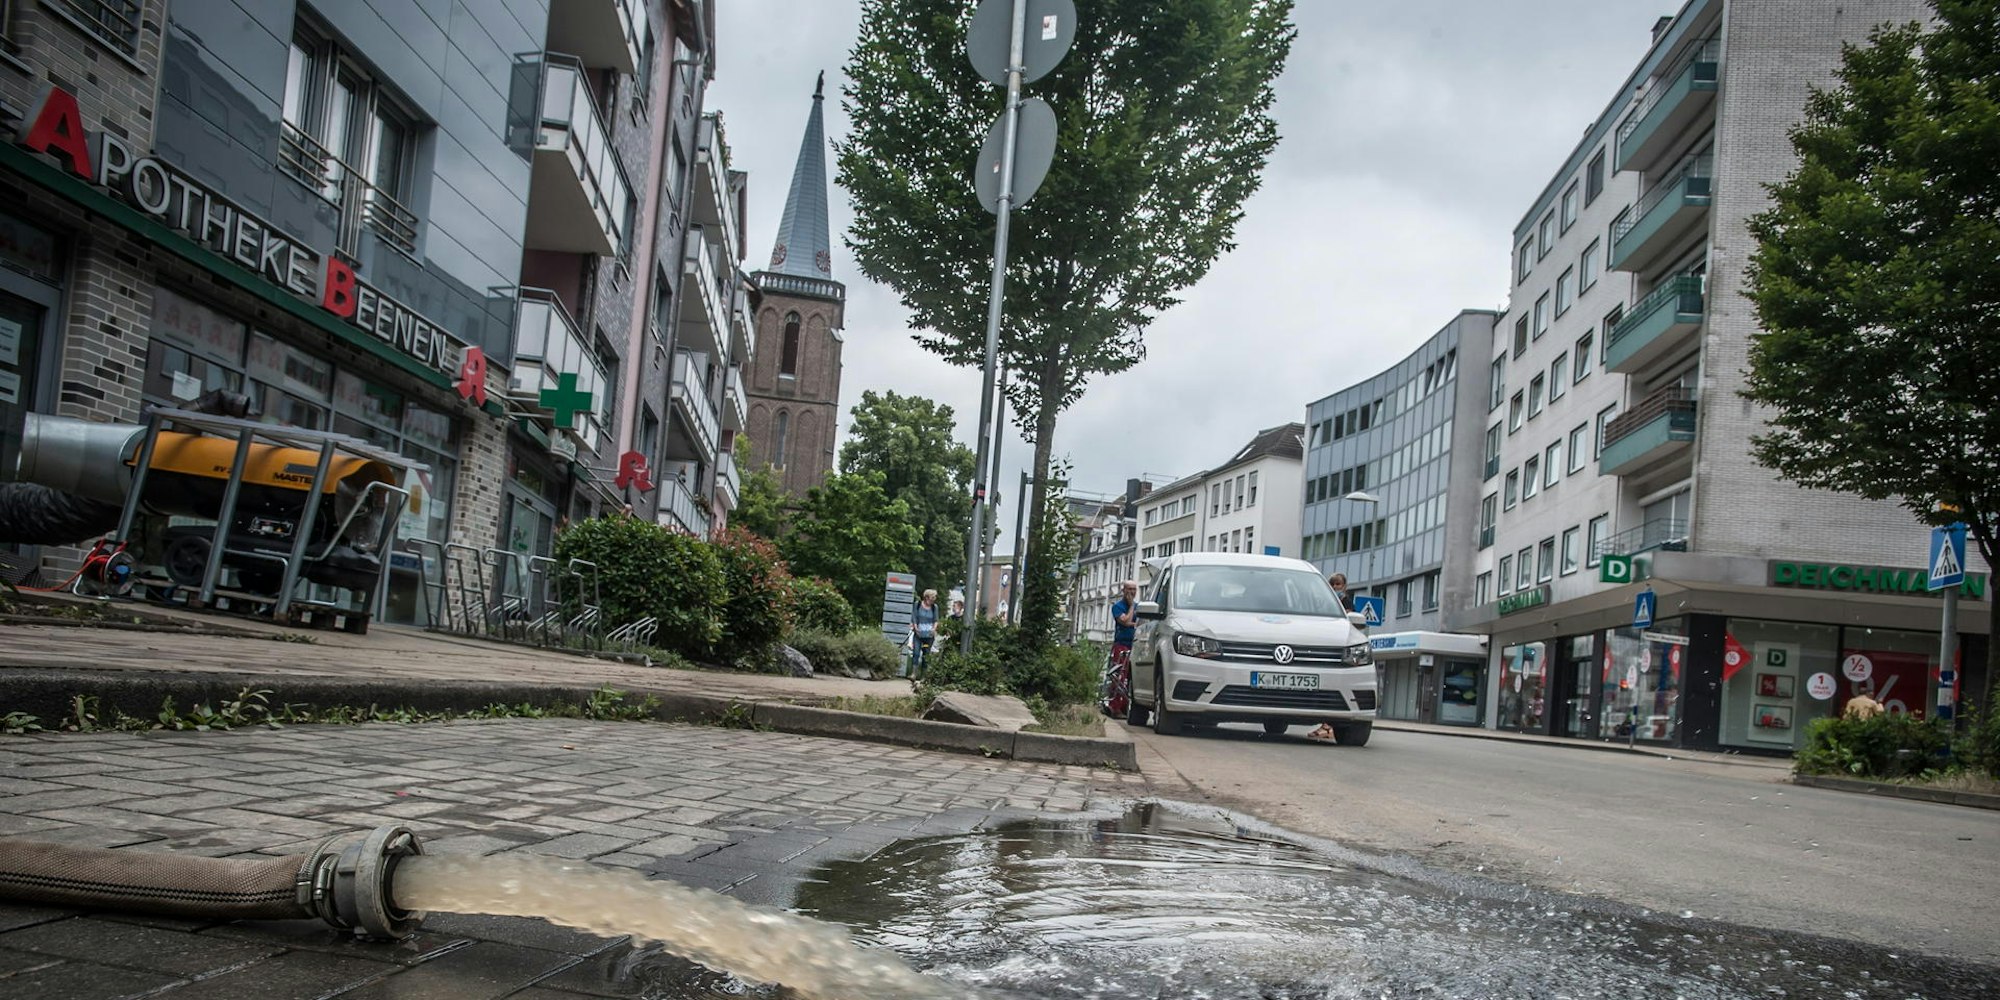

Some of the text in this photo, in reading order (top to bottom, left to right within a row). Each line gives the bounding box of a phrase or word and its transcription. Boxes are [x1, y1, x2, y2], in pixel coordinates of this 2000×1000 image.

[24, 86, 448, 371] APOTHEKE BEENEN
[273, 472, 314, 484] MASTE
[1608, 560, 1627, 578] D
[1775, 562, 1985, 597] DEICHMAN
[1258, 674, 1318, 687] K MT 1753
